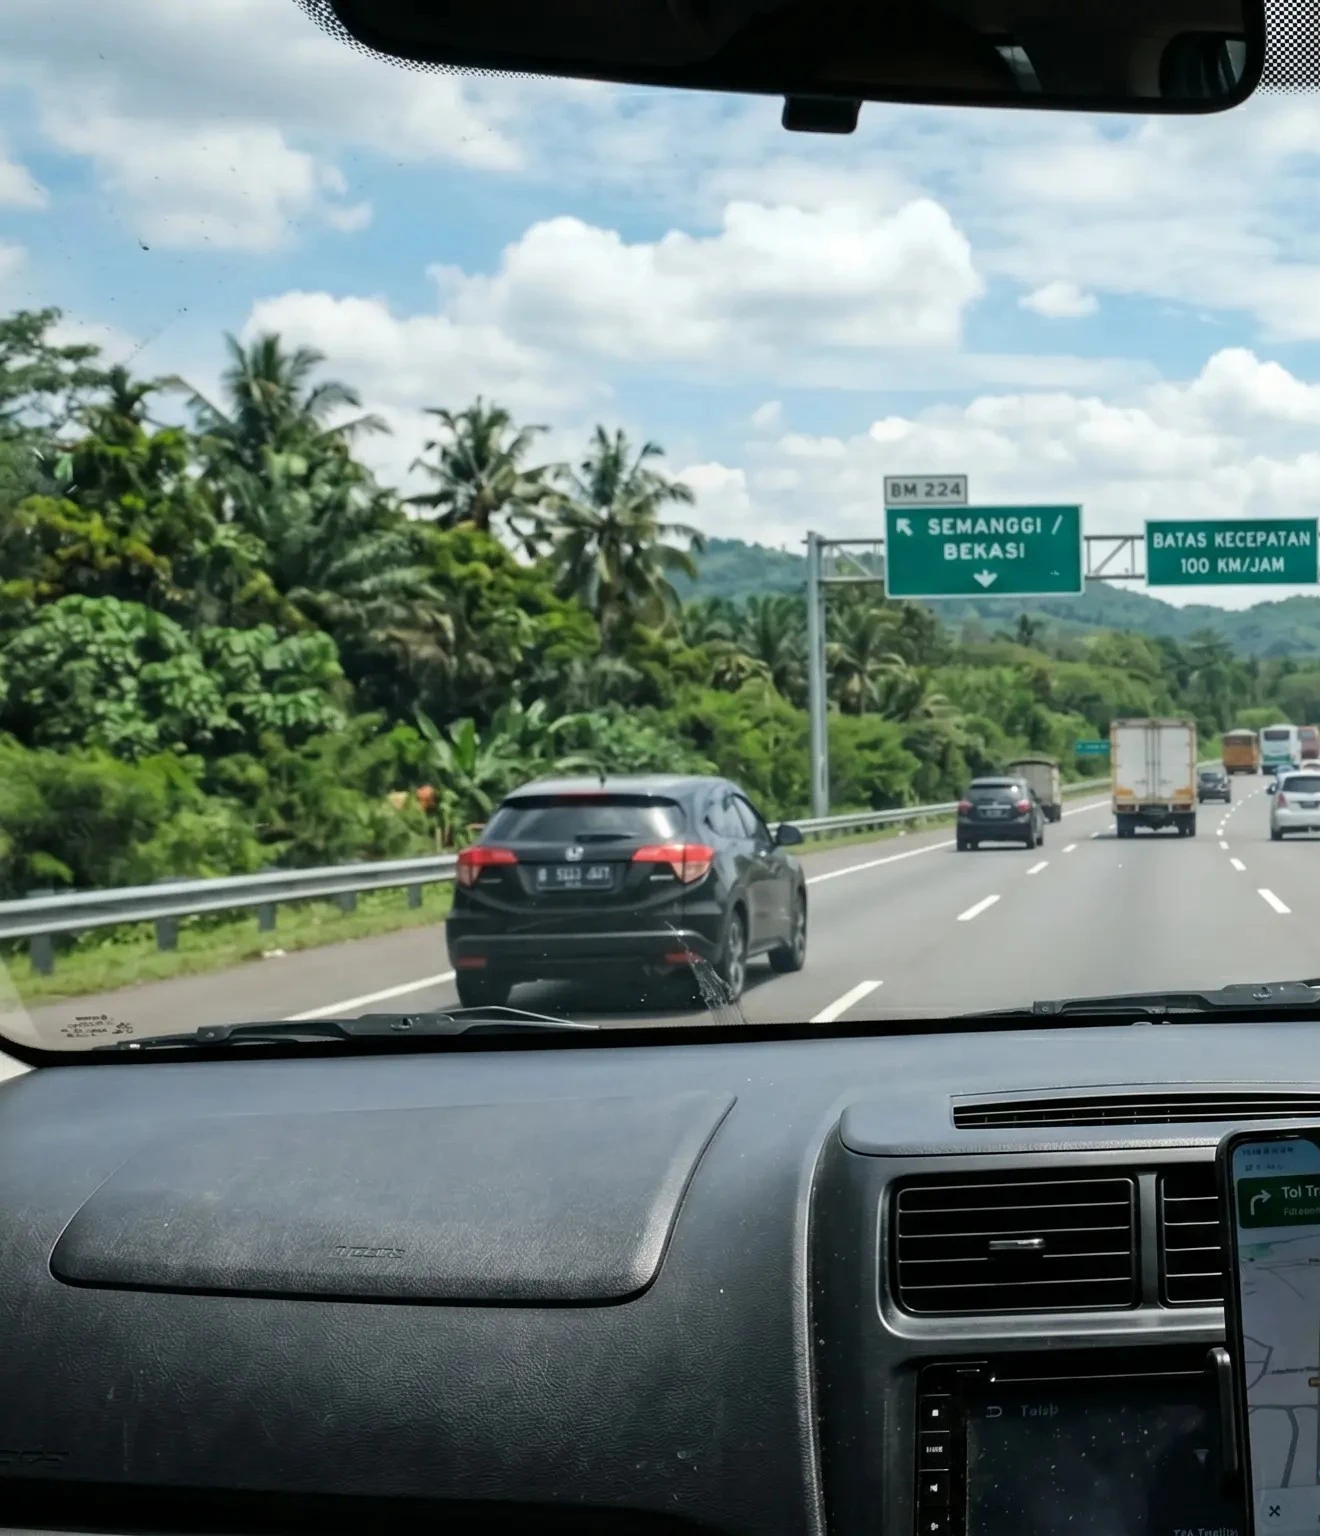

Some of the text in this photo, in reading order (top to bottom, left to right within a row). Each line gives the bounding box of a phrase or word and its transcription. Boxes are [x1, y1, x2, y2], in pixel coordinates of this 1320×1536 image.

[890, 482, 962, 498] BM 224
[927, 514, 1063, 535] SEMANGGI /
[1153, 530, 1311, 549] BATAS KECEPATAN
[943, 542, 1025, 560] BEKASI
[1181, 556, 1285, 574] 100 KM/JAM
[1281, 1185, 1302, 1199] Tol
